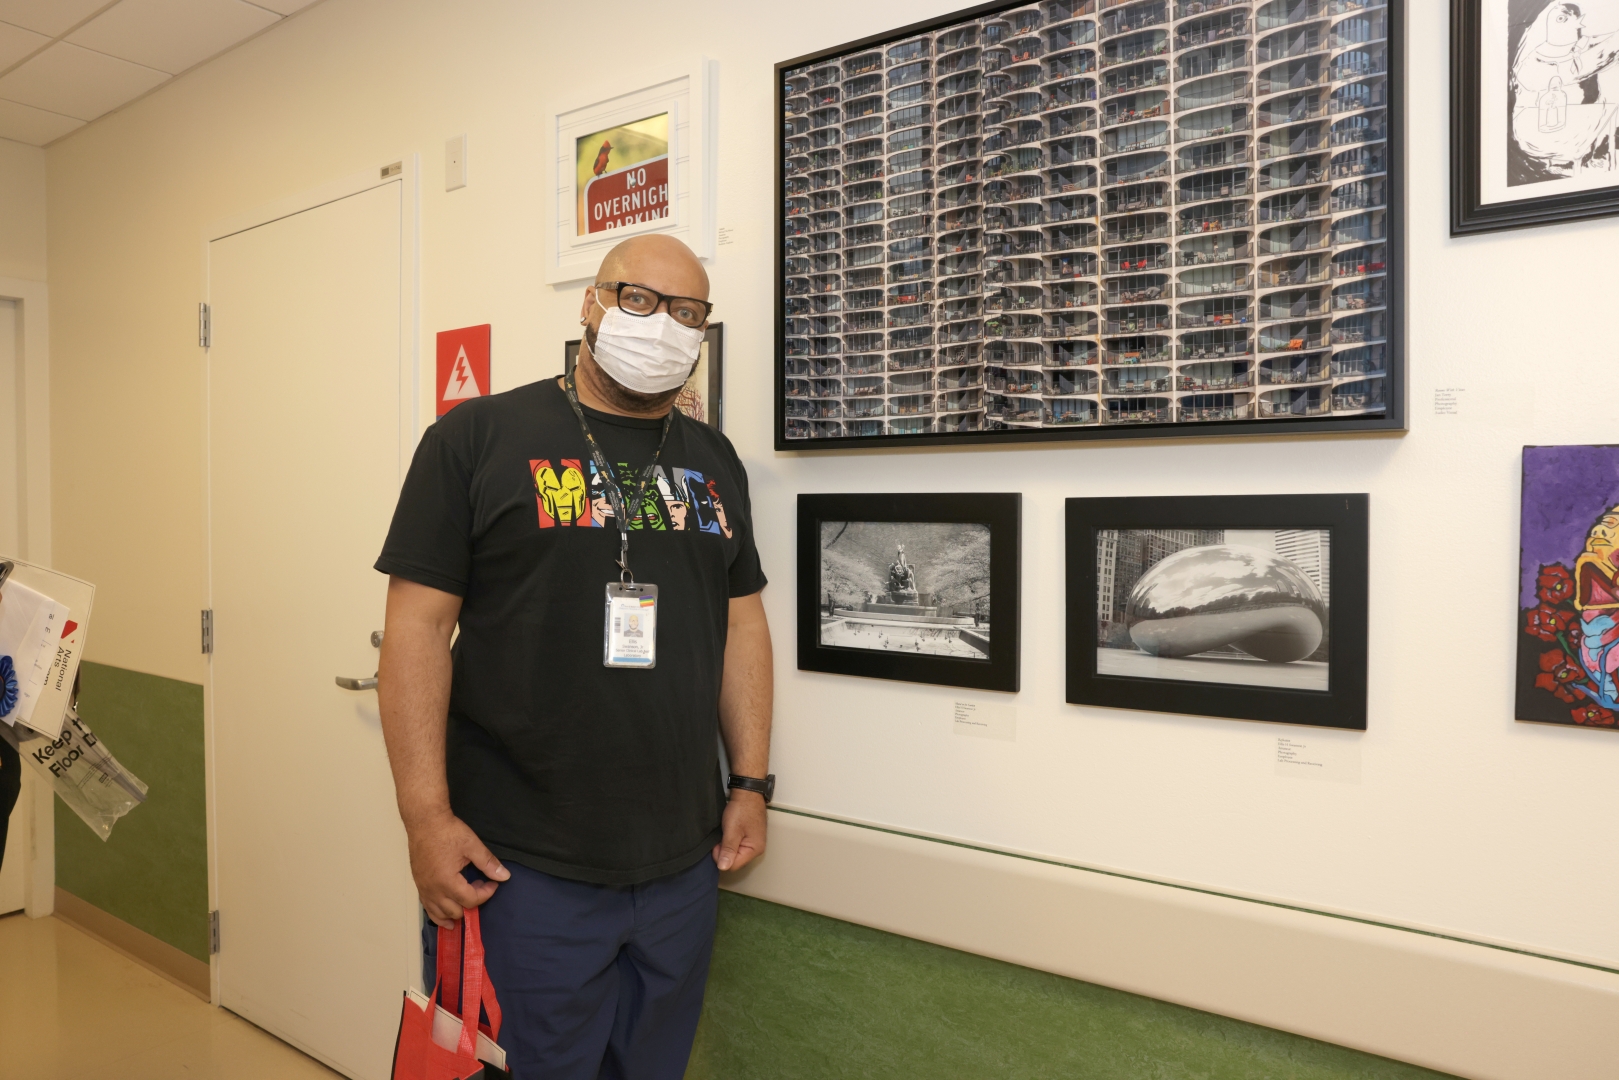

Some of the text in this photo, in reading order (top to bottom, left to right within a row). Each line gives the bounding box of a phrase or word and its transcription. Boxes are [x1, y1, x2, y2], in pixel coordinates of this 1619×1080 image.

[627, 168, 646, 190] NO
[53, 645, 63, 668] Arts
[55, 648, 72, 692] National
[32, 730, 72, 764] Keep
[48, 745, 84, 778] Floor
